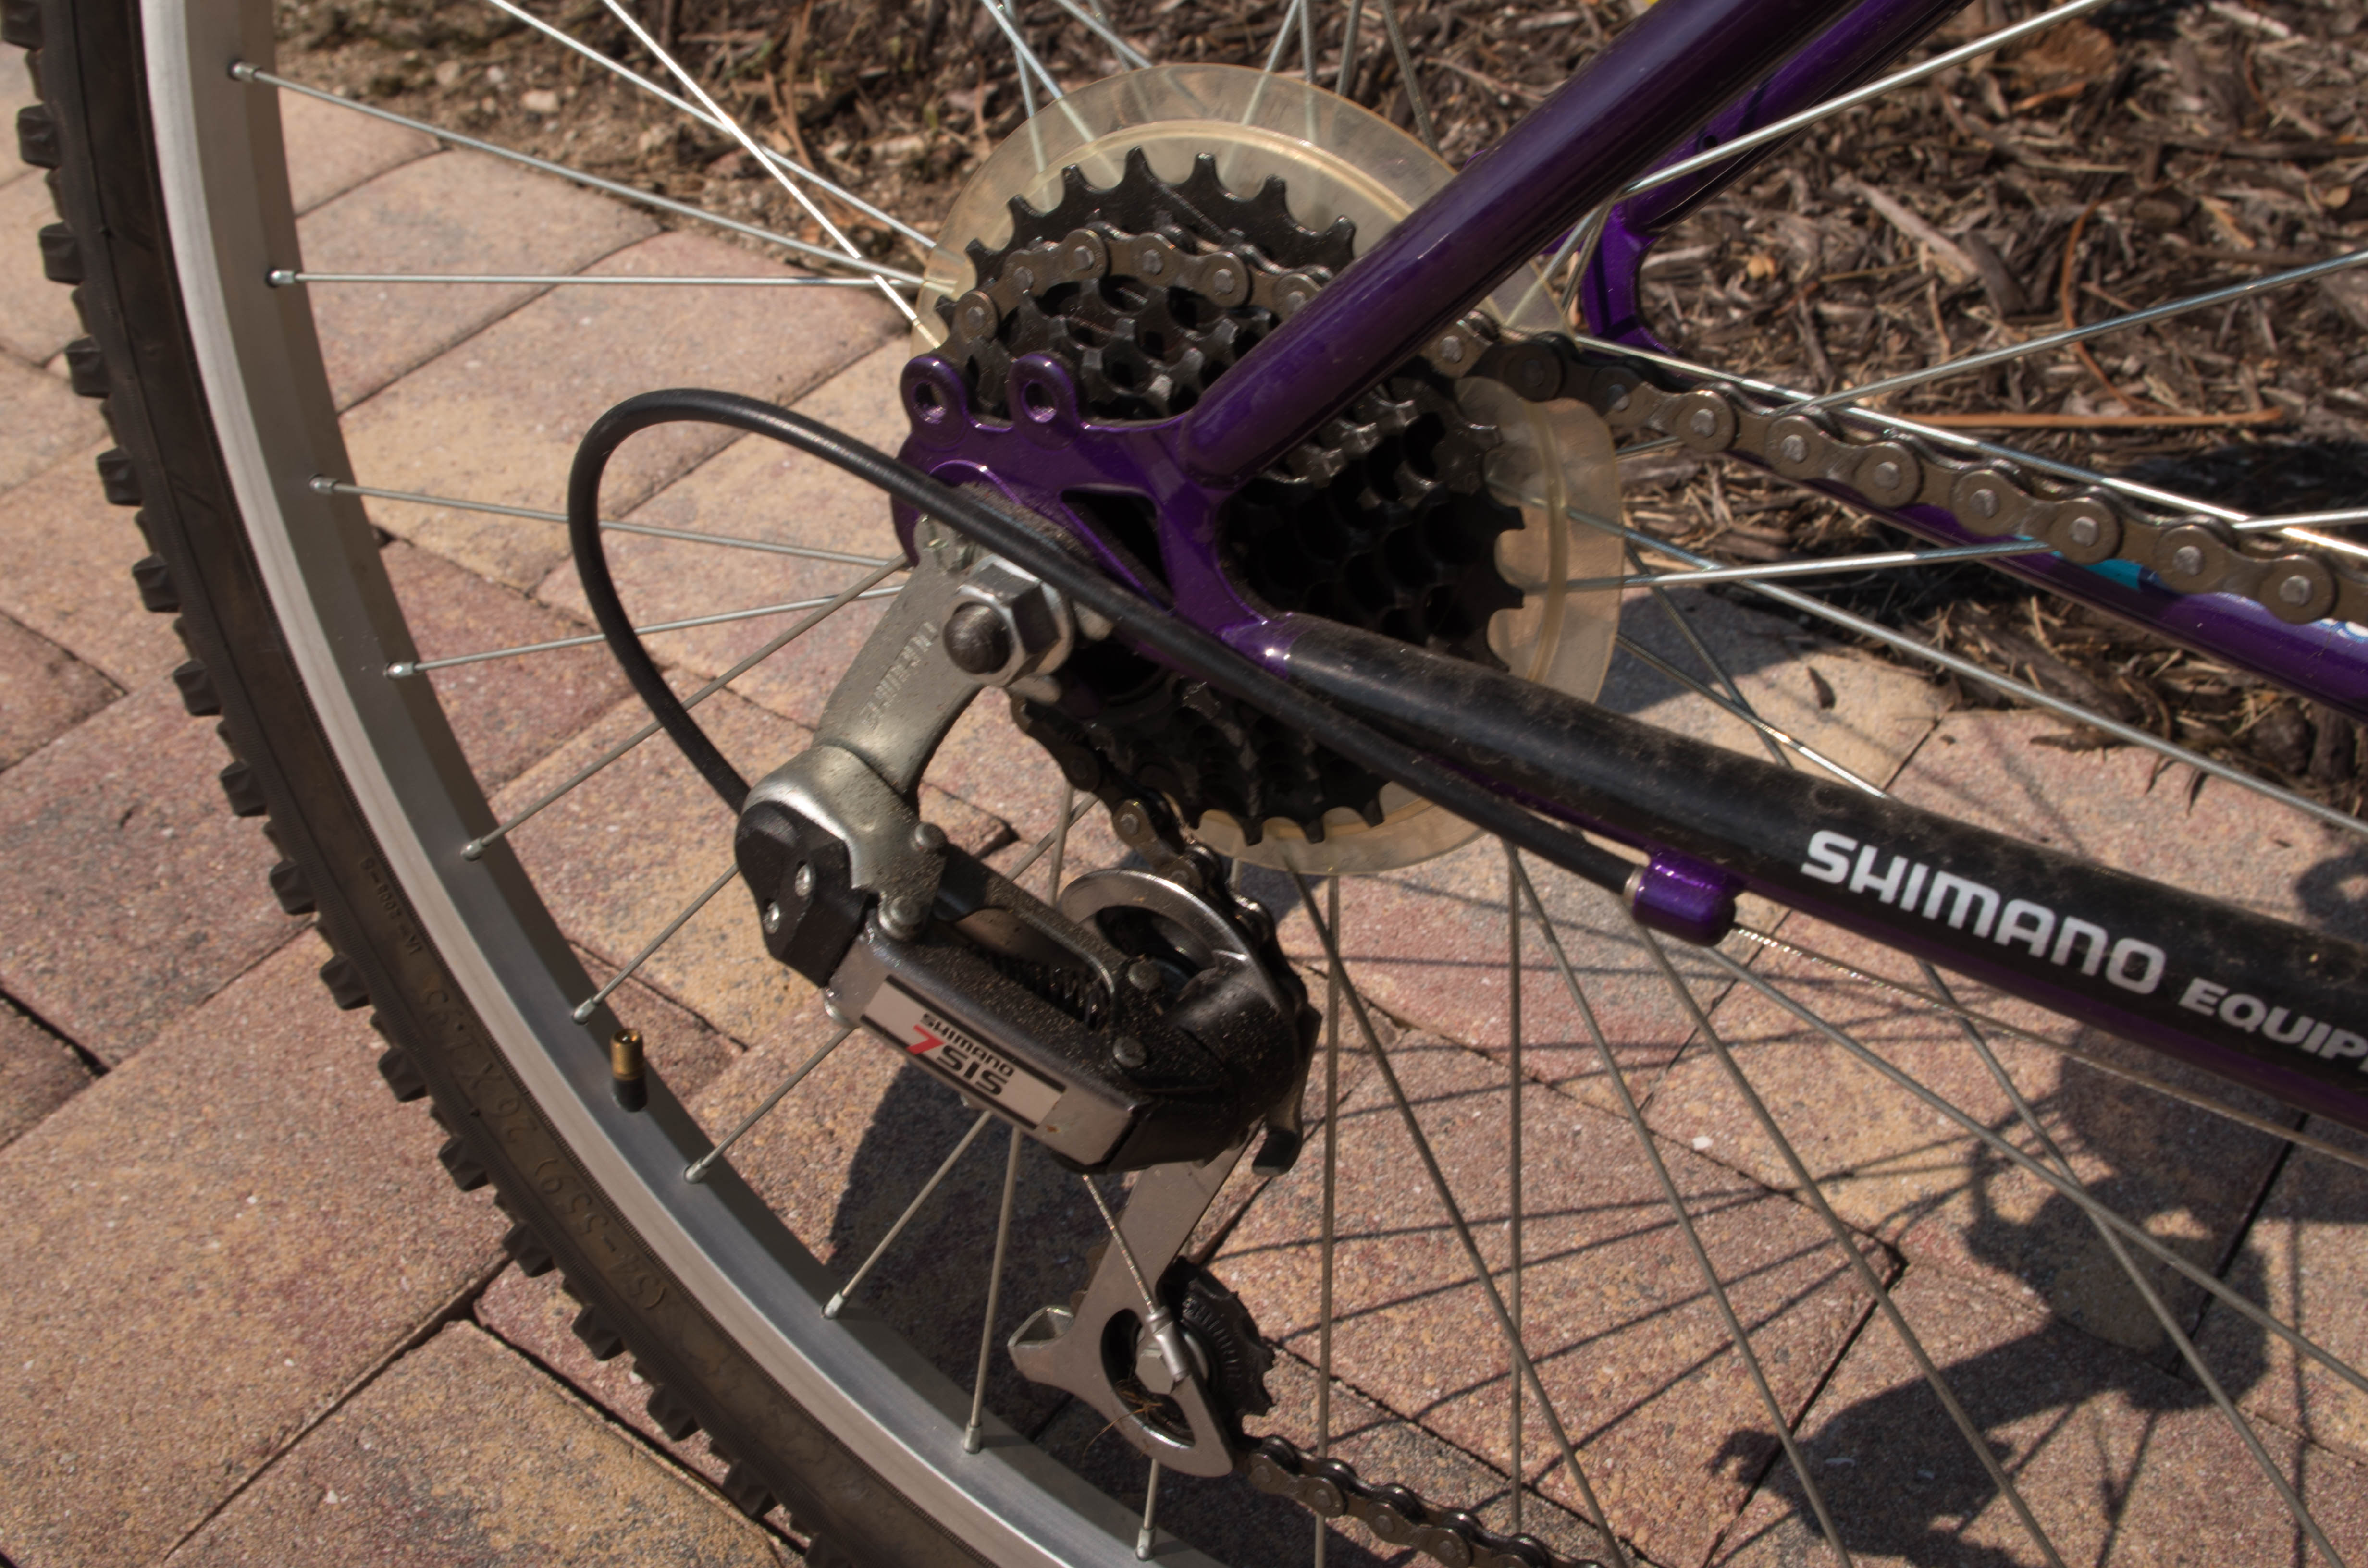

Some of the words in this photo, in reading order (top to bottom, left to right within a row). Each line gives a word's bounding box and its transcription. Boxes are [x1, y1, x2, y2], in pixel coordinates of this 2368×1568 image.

[1800, 830, 2166, 995] SHIMANO
[2178, 976, 2368, 1074] EQUIP
[921, 1013, 1014, 1077] SHIMANO
